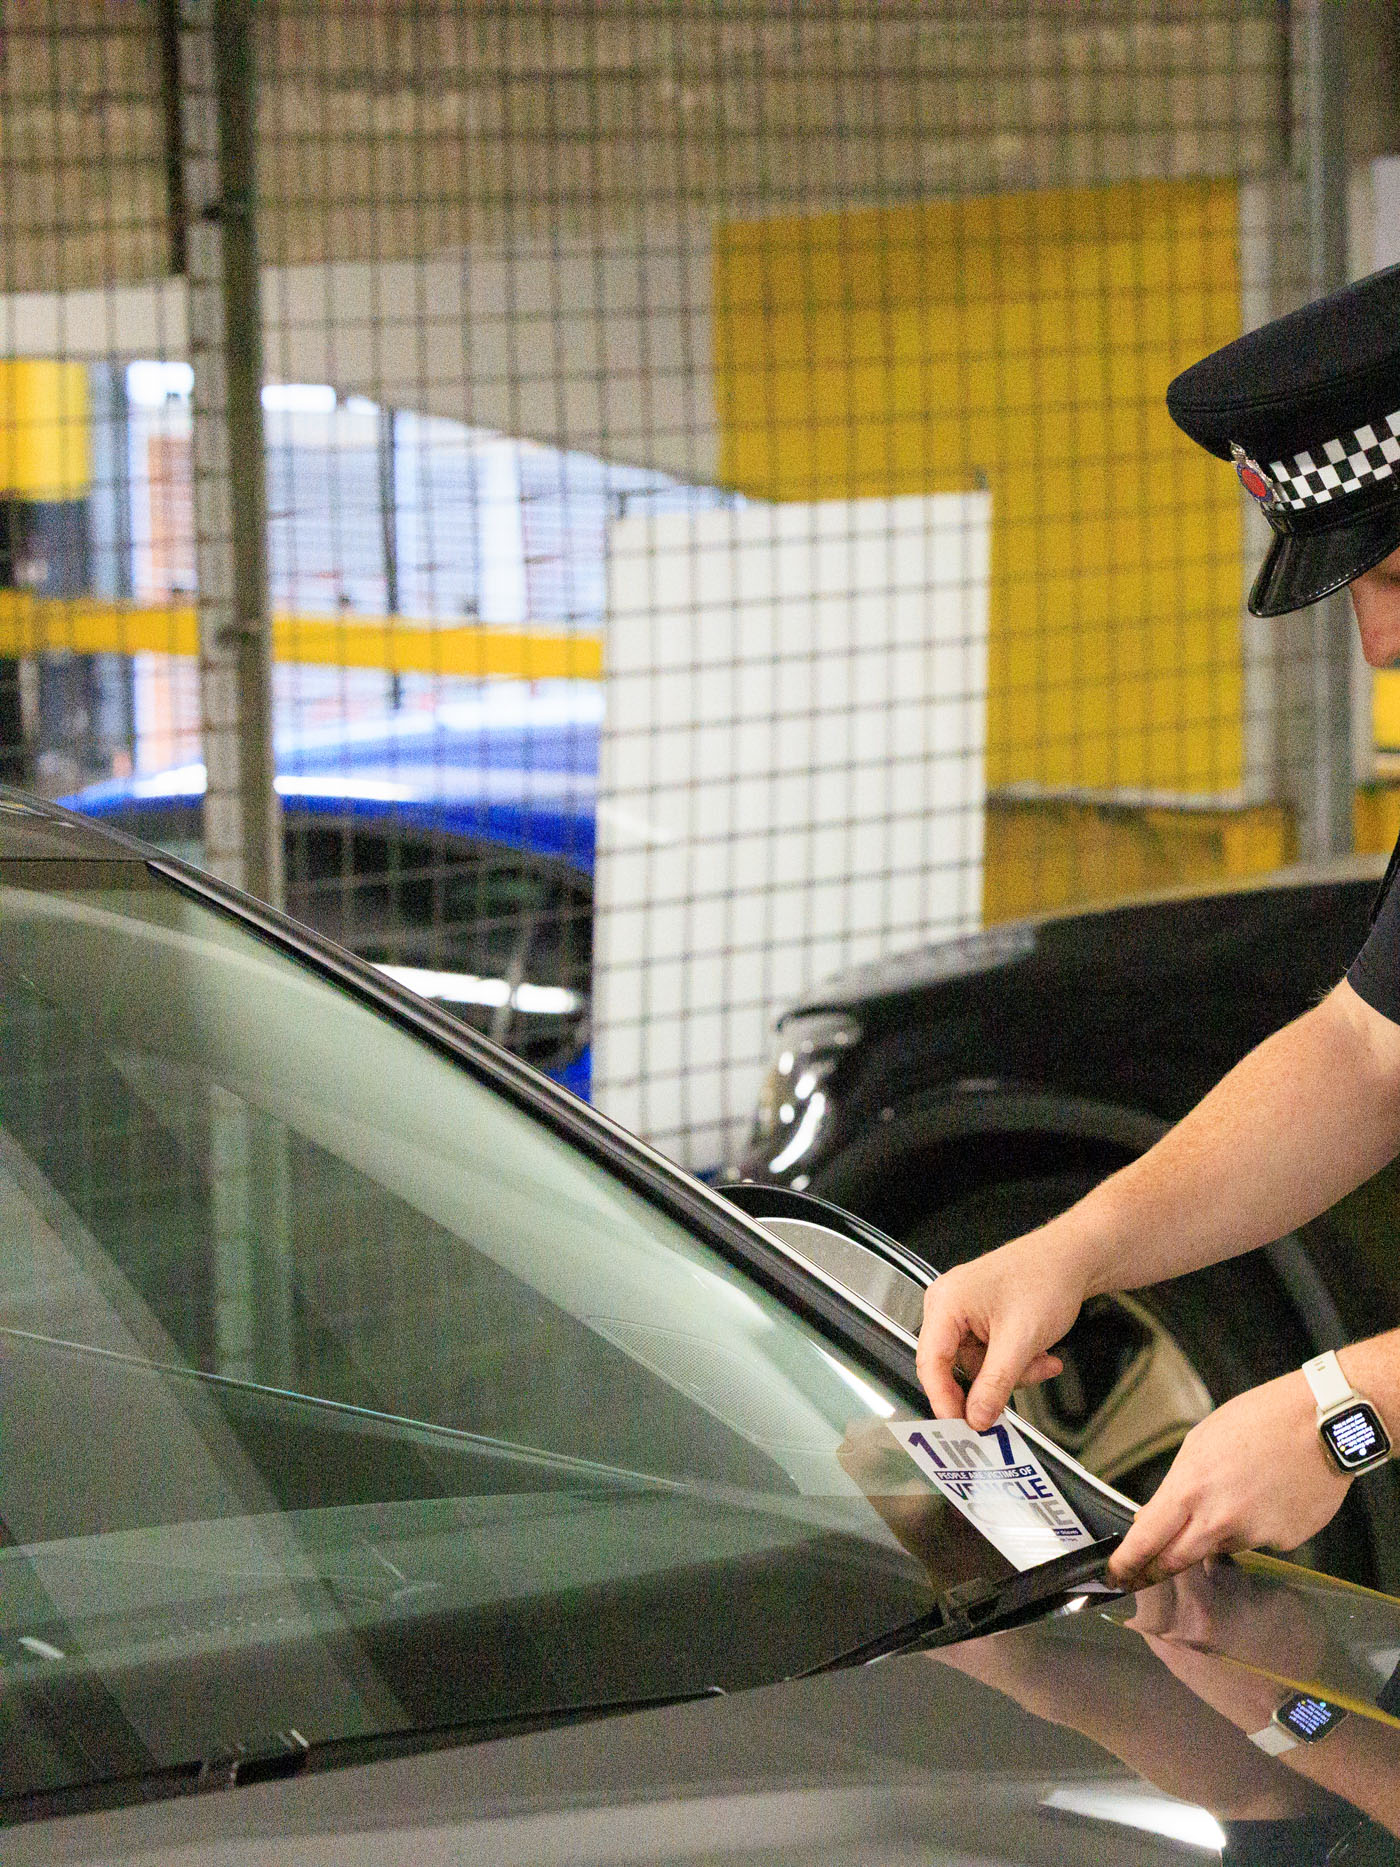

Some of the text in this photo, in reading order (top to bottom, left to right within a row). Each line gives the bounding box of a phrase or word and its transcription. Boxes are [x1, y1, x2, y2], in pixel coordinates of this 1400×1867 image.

[908, 1425, 1015, 1468] 1 in 7
[937, 1466, 1033, 1480] PEOPLE ARE VICTIMS OF
